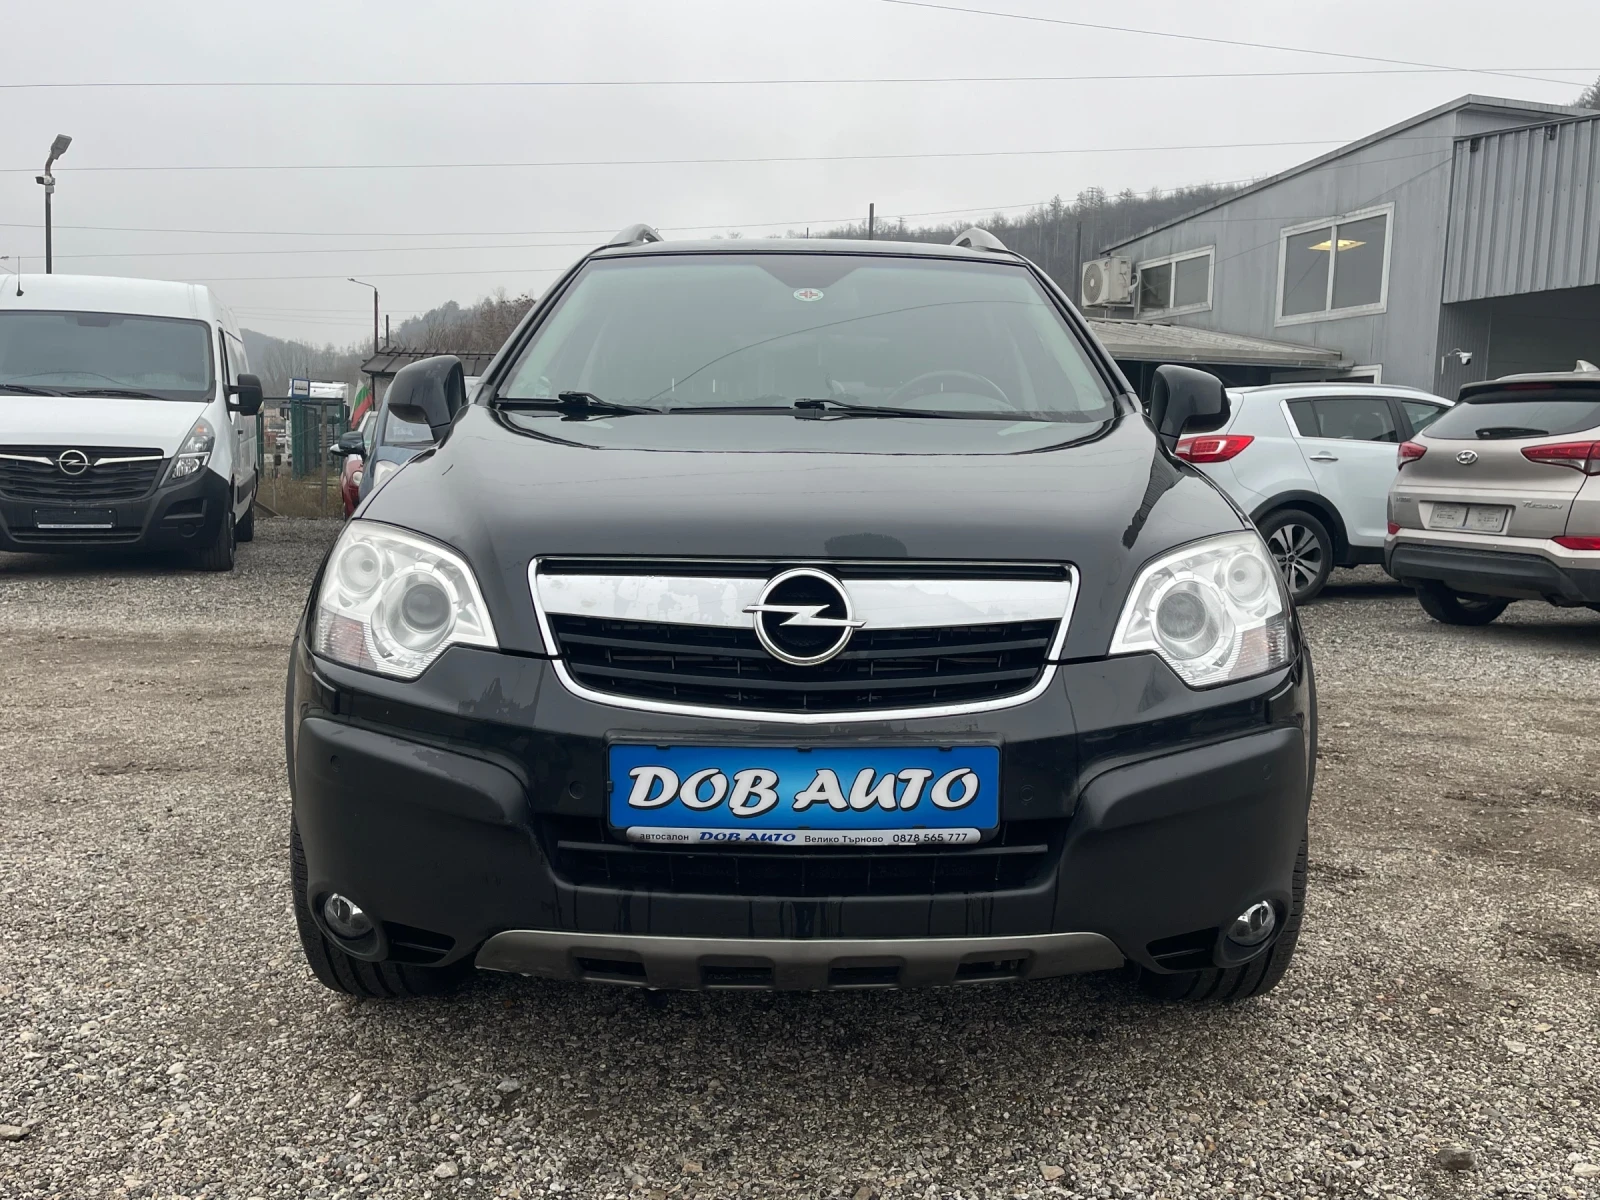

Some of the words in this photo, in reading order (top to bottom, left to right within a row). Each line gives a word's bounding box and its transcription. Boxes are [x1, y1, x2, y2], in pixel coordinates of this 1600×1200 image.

[628, 765, 779, 818] DOB
[792, 767, 980, 812] AUTO
[640, 833, 689, 841] автосалон
[699, 832, 741, 842] DOB
[744, 832, 796, 842] AUTO
[804, 834, 840, 844] Велико
[842, 834, 883, 845] Търново
[892, 833, 920, 843] 0878
[923, 833, 945, 843] 565
[947, 832, 968, 842] 777
